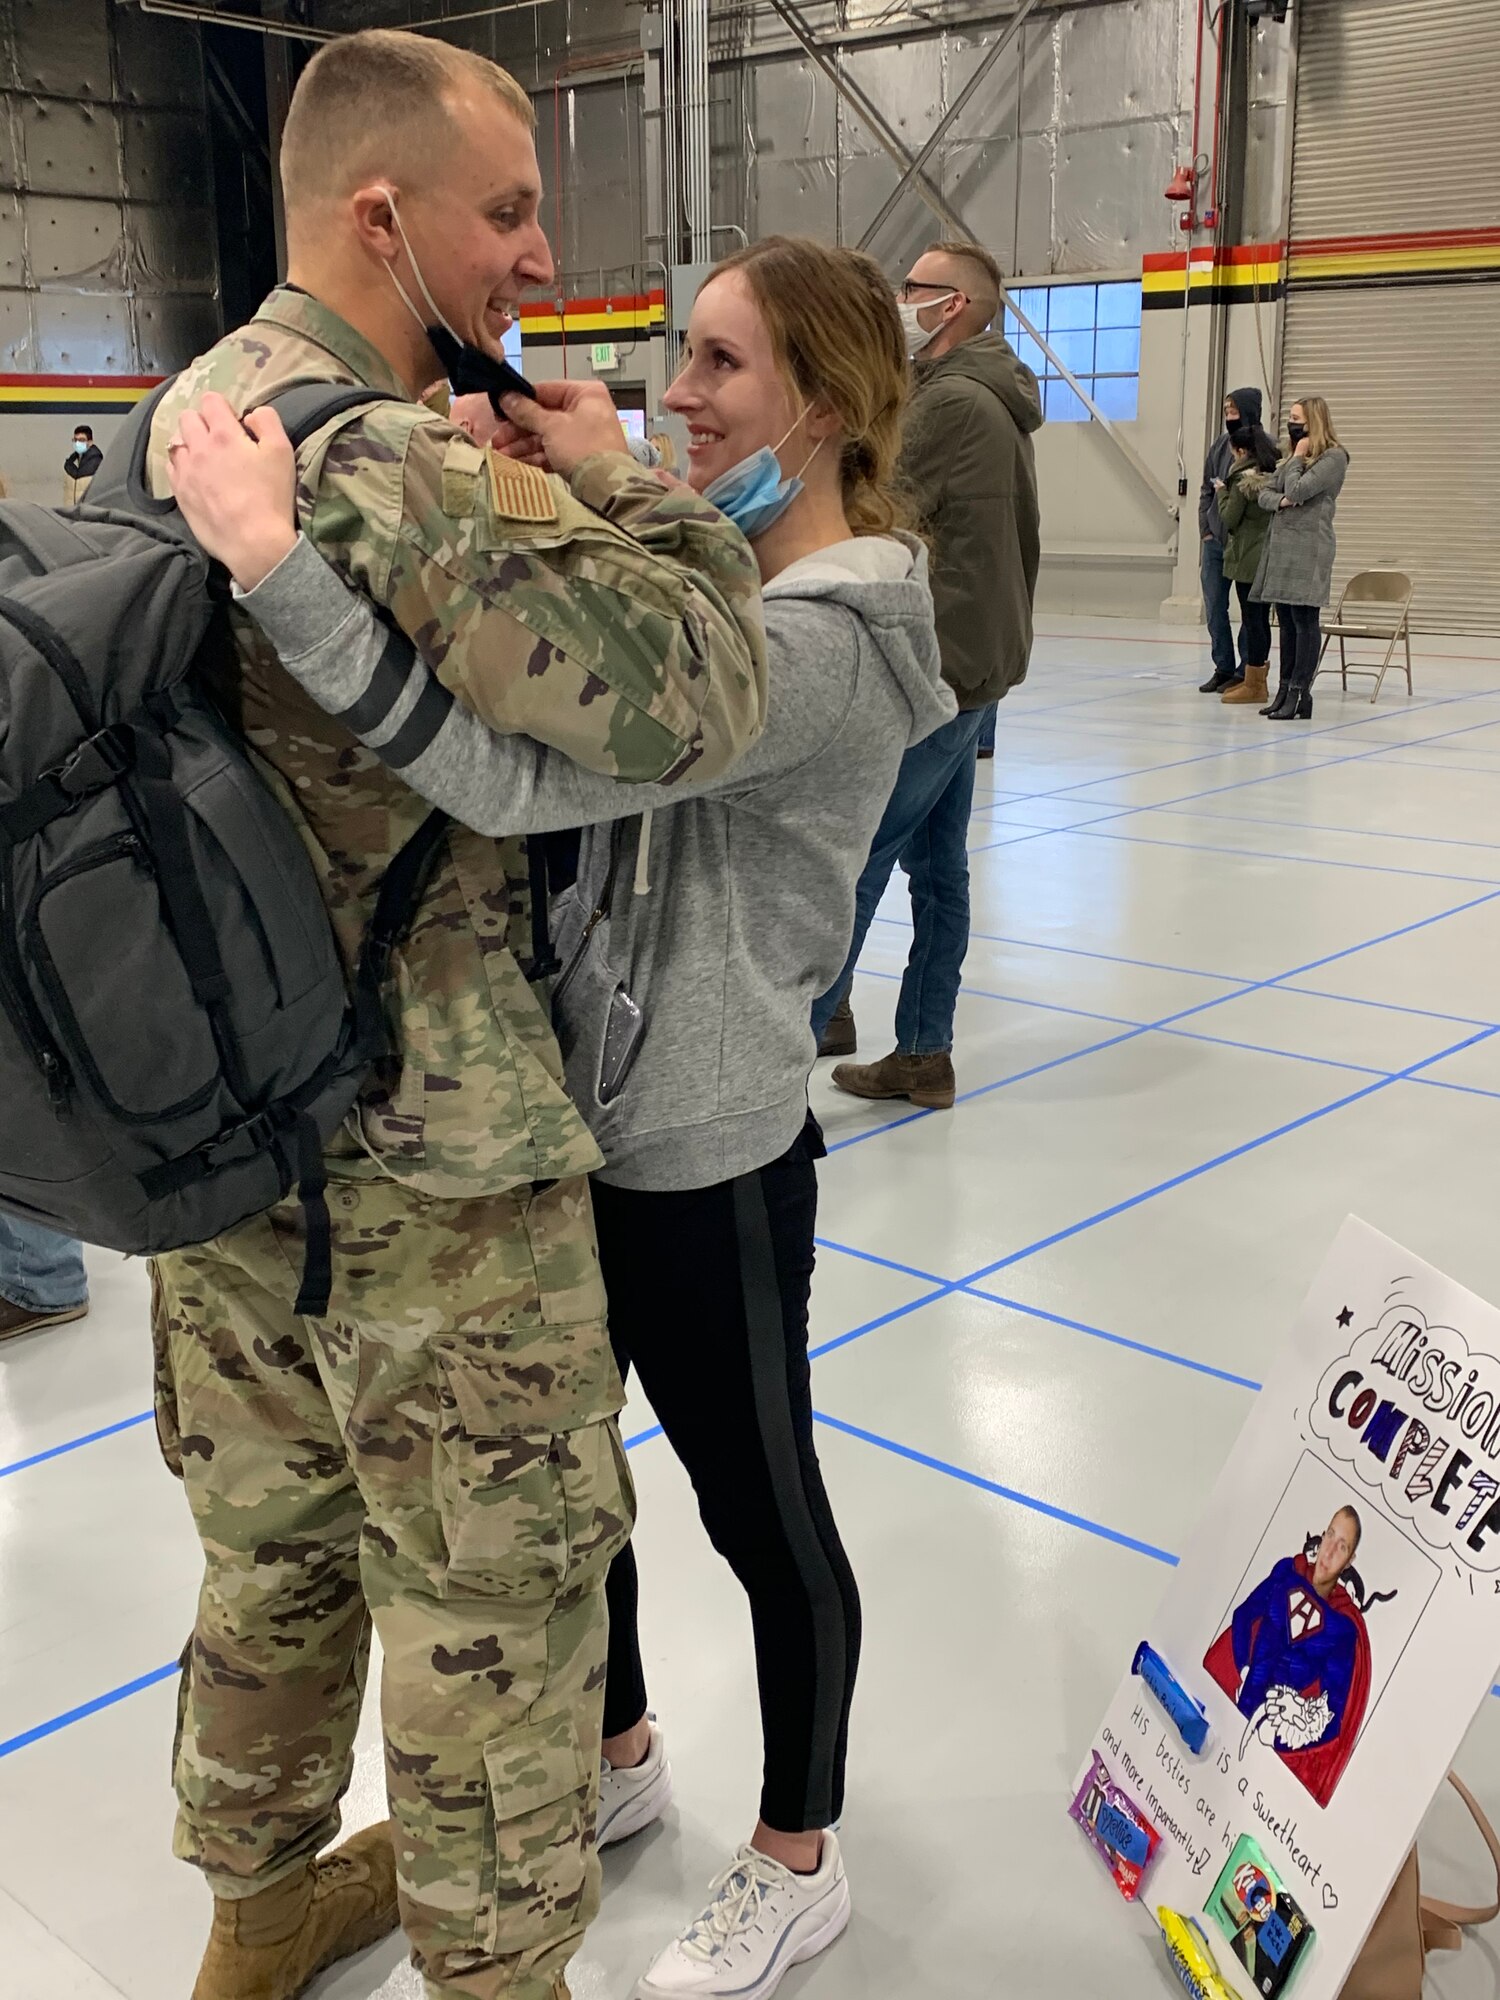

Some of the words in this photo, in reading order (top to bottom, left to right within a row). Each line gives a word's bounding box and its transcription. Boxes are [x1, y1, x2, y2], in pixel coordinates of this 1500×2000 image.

[594, 344, 610, 363] EXIT
[1102, 1727, 1119, 1758] and
[1121, 1751, 1144, 1791] more
[1145, 1785, 1196, 1863] Importantly
[1156, 1734, 1191, 1794] besties
[1196, 1798, 1216, 1827] are
[1222, 1821, 1237, 1853] hi
[1217, 1747, 1231, 1774] is
[1238, 1778, 1249, 1798] a
[1253, 1791, 1322, 1887] Sweetheart
[1232, 1861, 1257, 1893] Kit
